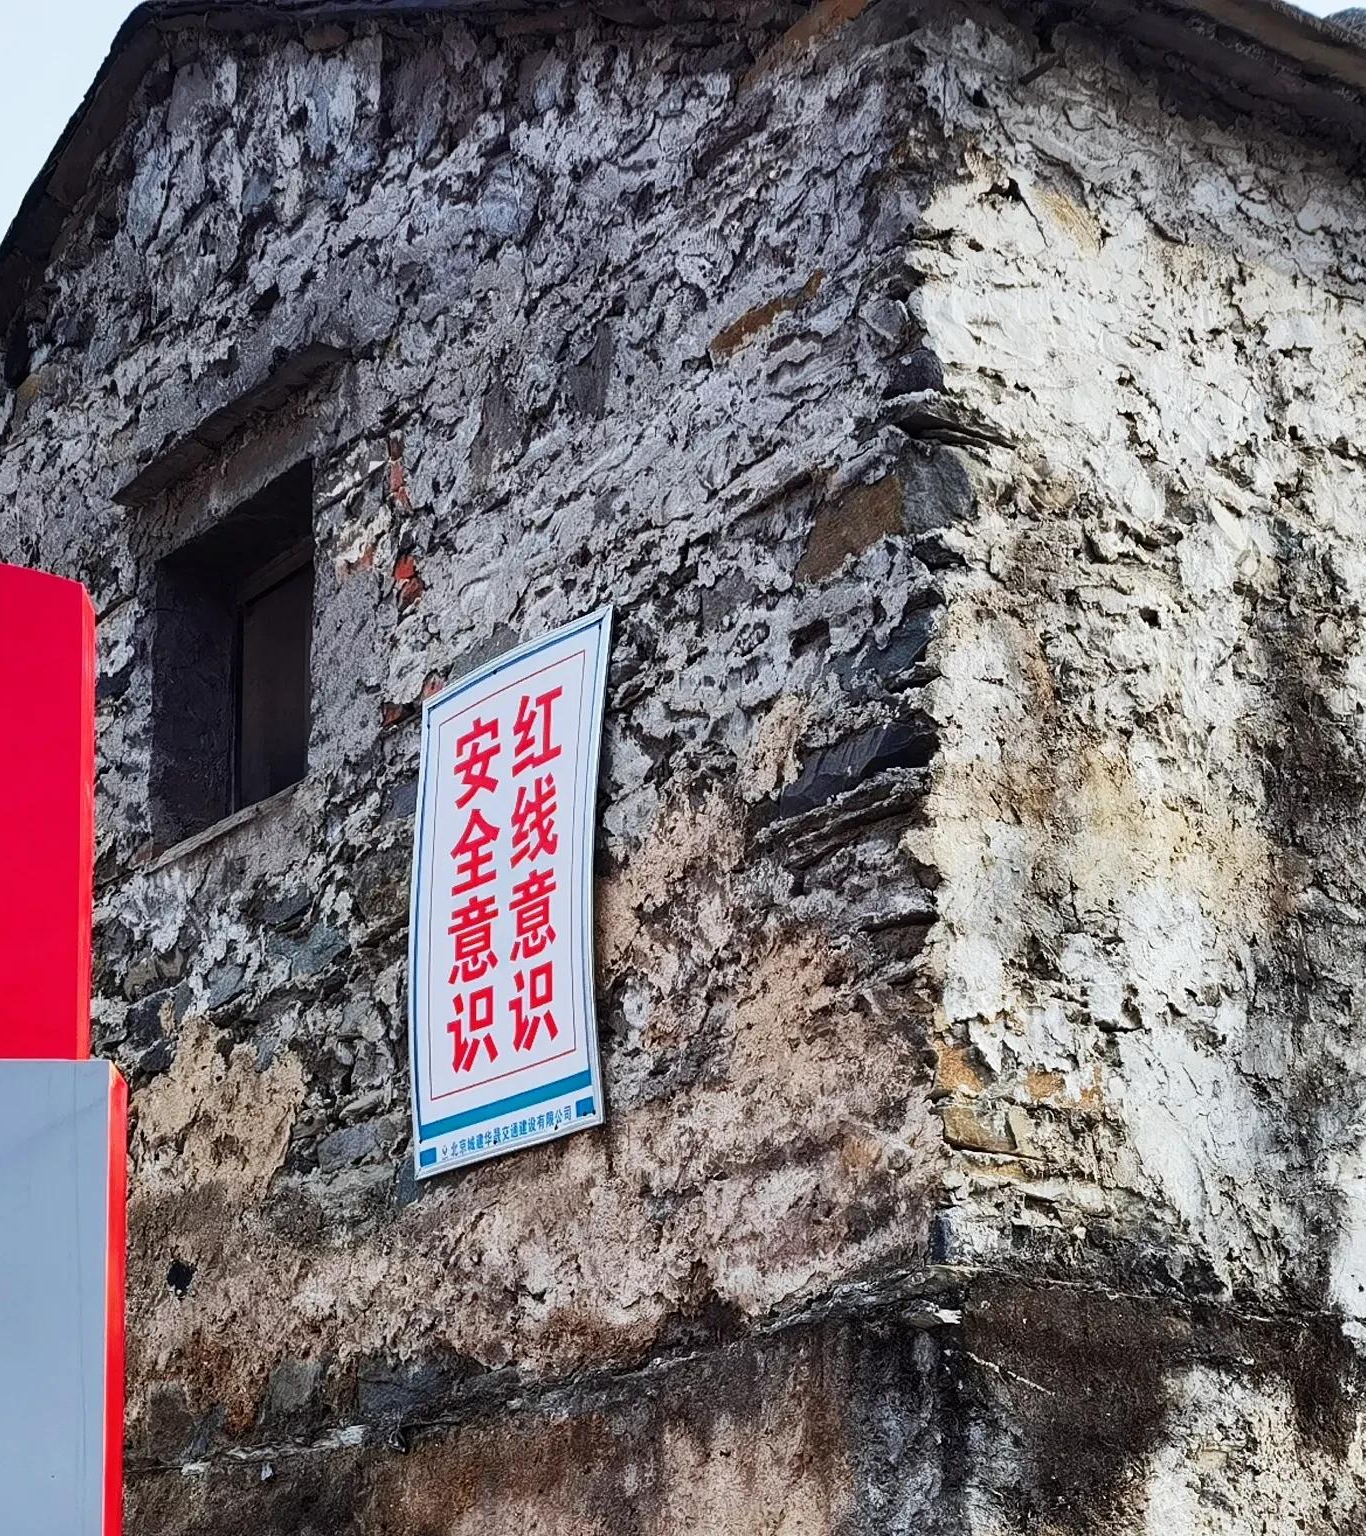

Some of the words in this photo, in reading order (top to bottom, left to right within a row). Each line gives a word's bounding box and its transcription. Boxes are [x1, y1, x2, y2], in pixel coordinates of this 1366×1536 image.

[446, 717, 501, 1073] 安全意识
[509, 685, 563, 1053] 红线意识
